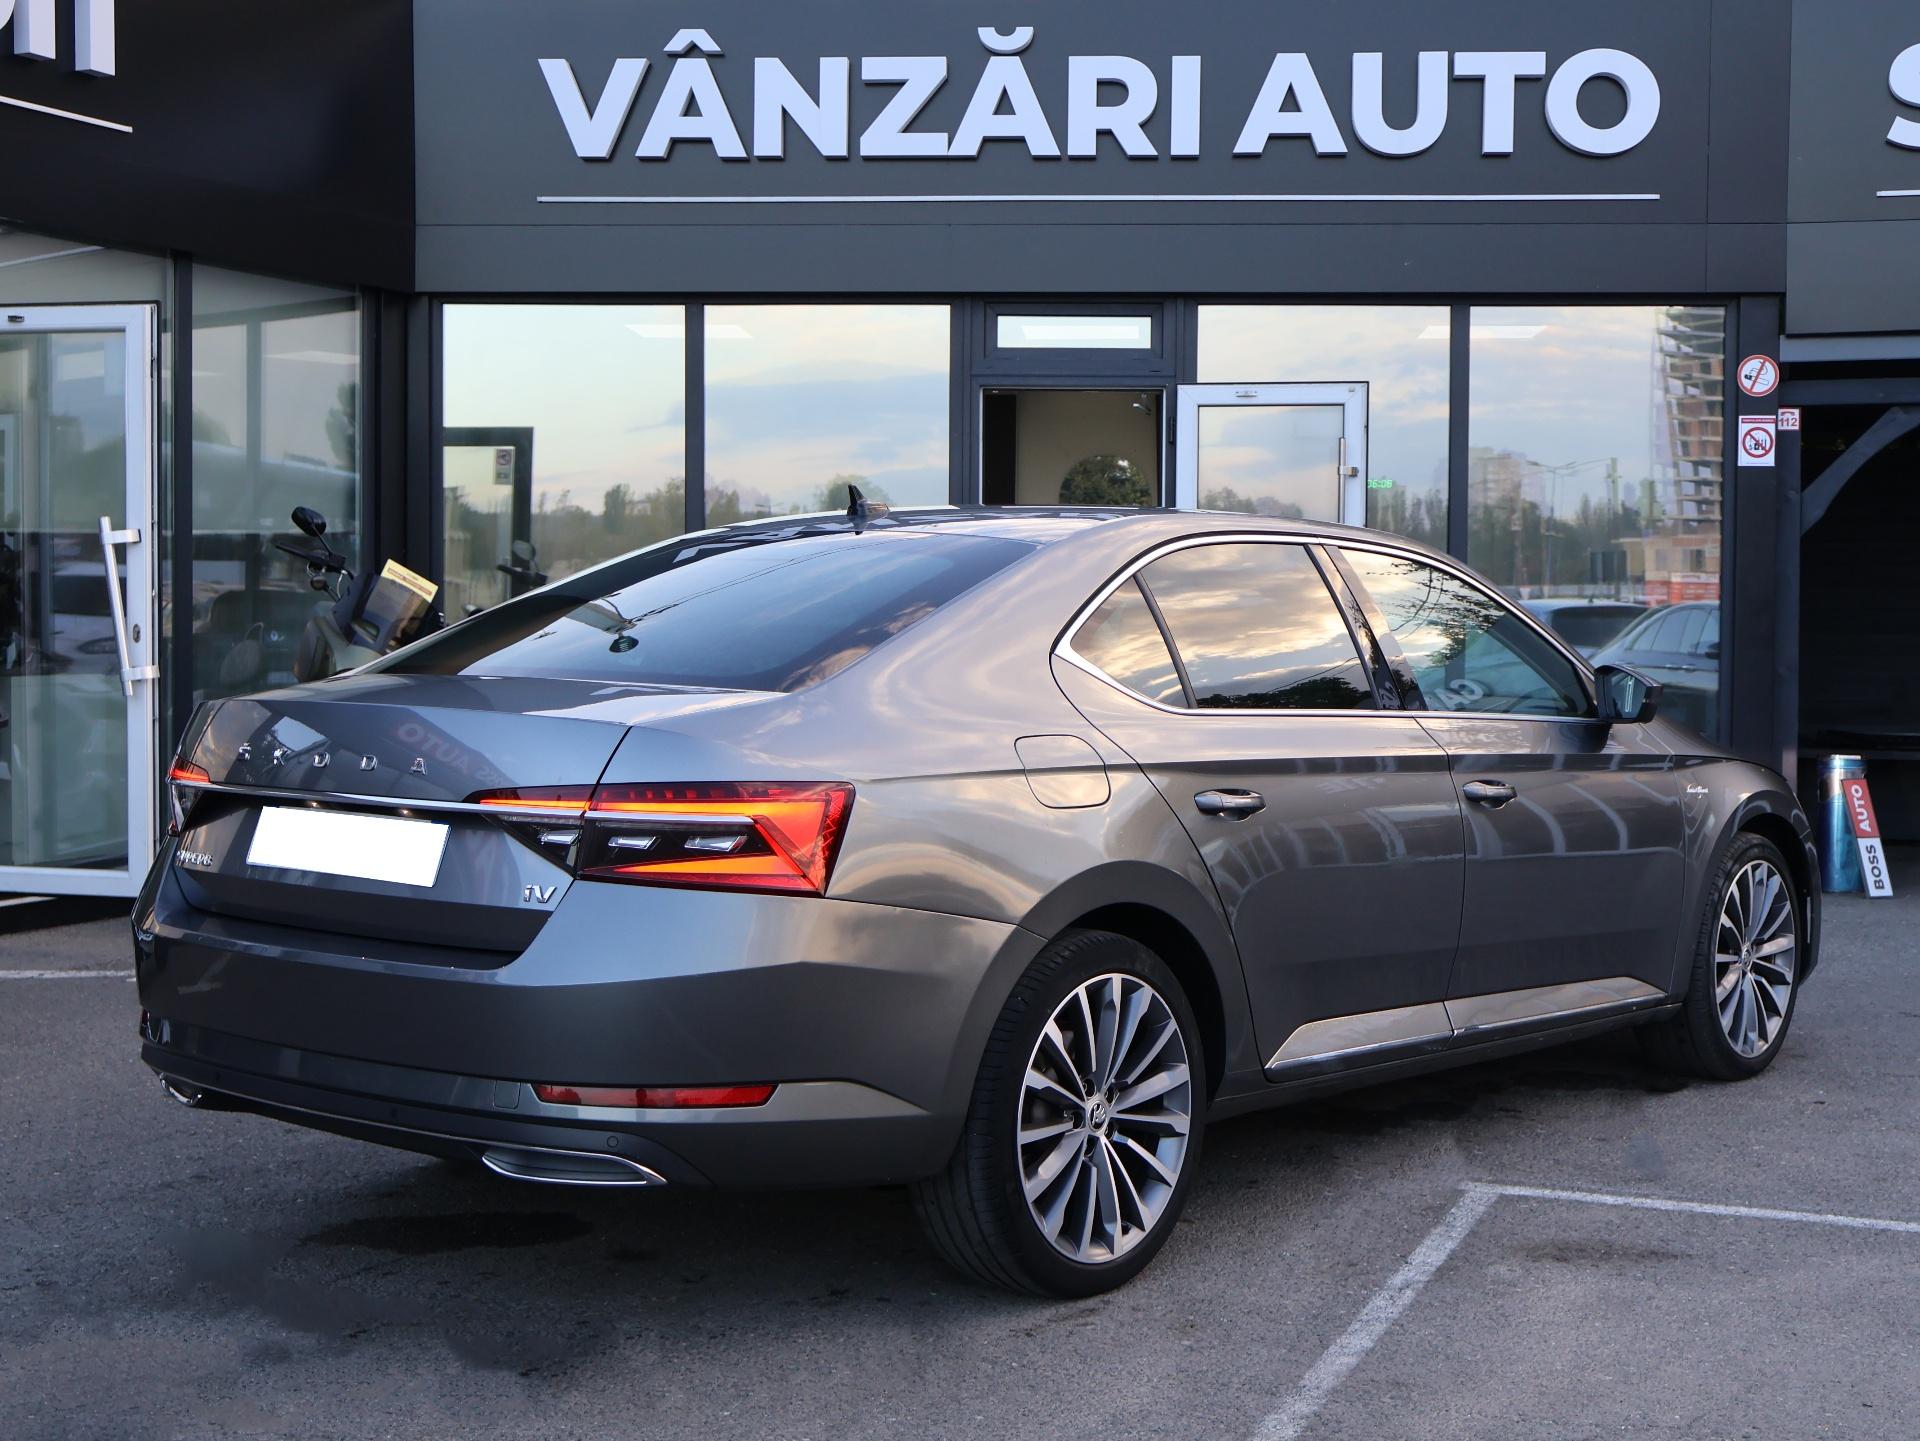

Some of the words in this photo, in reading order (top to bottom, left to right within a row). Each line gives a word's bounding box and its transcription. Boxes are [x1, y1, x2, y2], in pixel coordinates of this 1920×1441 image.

[538, 26, 1201, 159] VÂNZĂRI
[1232, 48, 1660, 157] AUTO
[1779, 417, 1798, 427] 112
[1851, 784, 1872, 832] AUTO
[1865, 844, 1885, 890] BOSS
